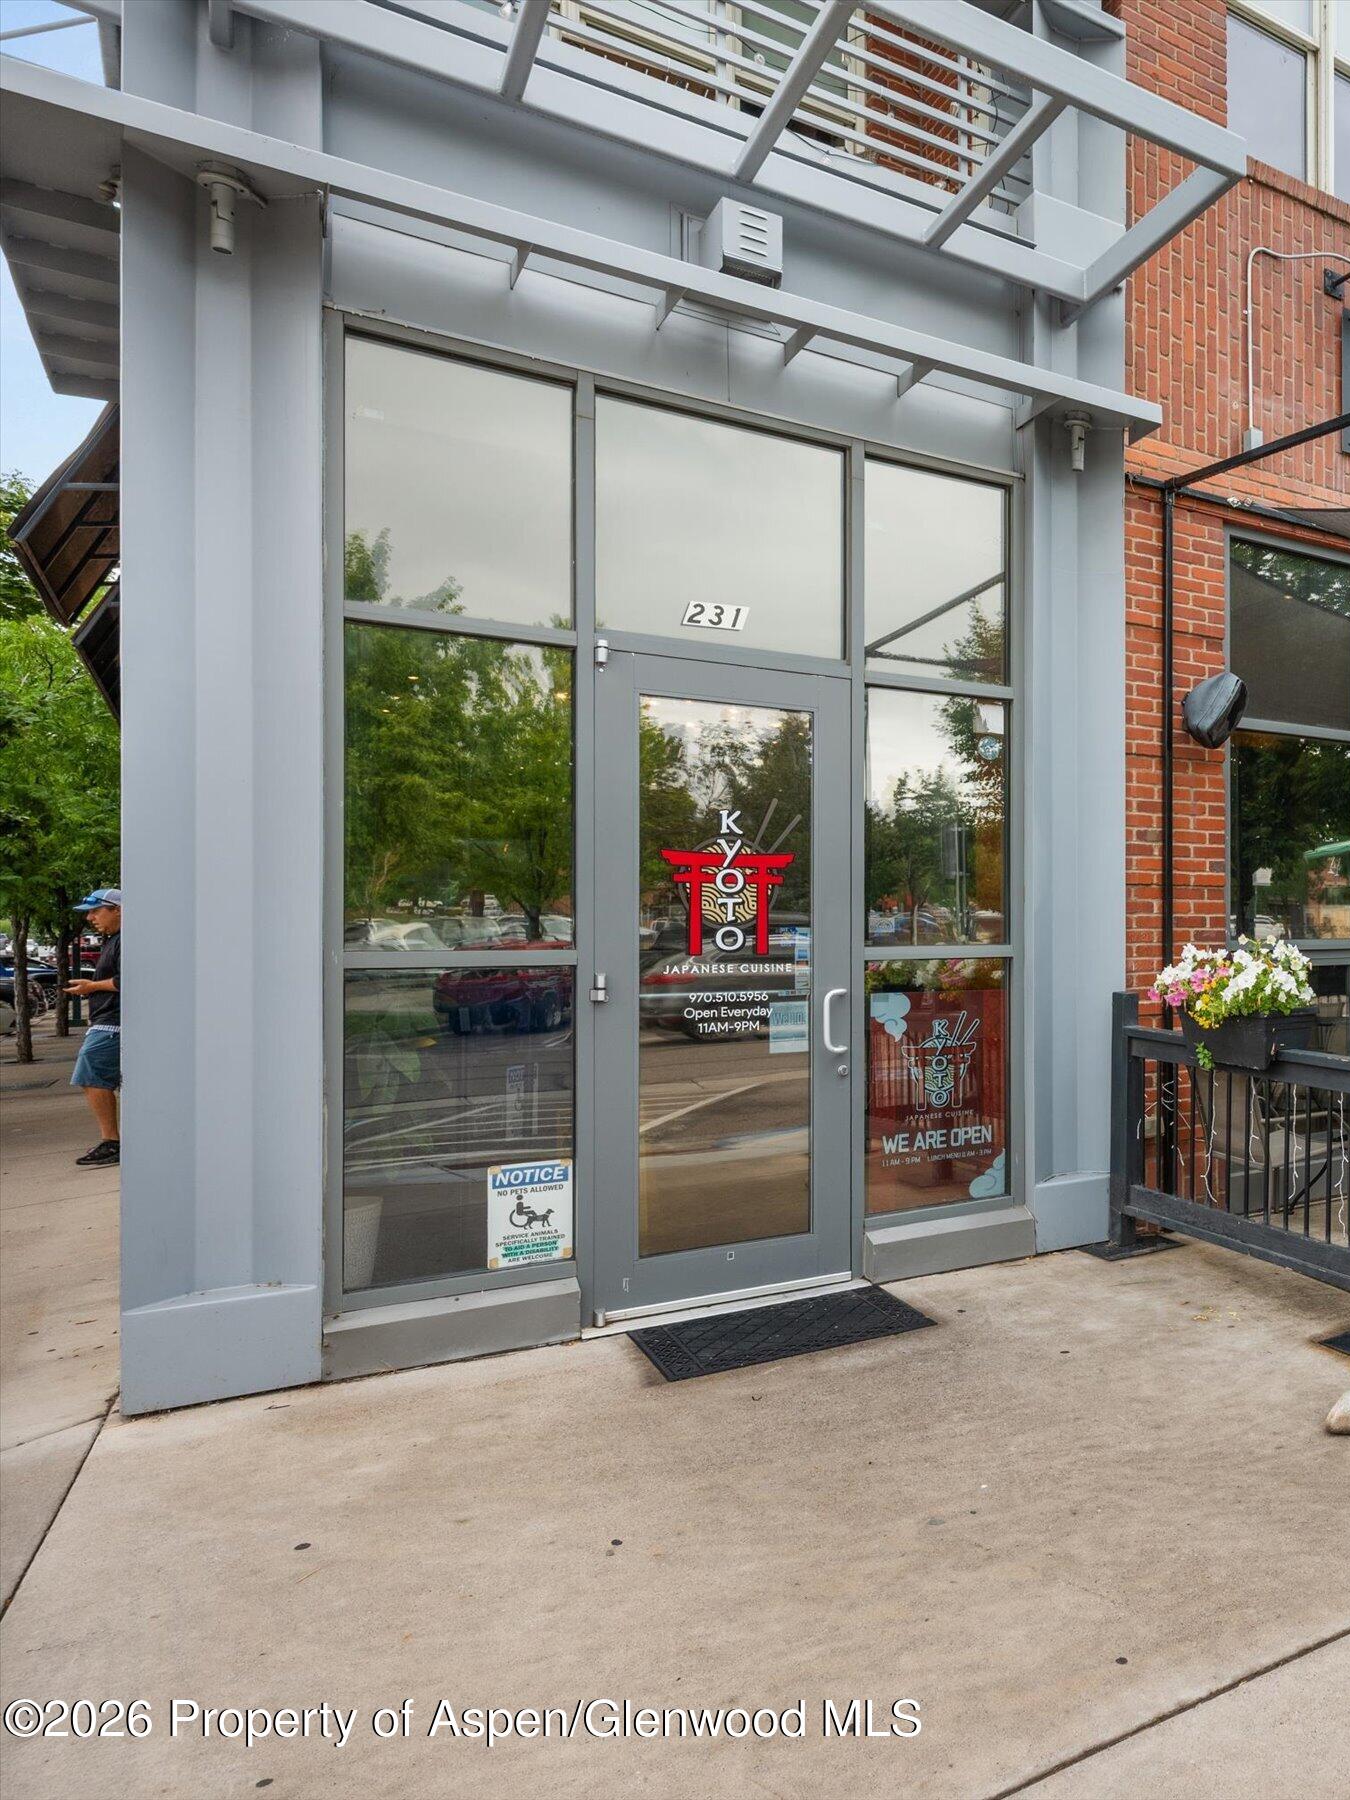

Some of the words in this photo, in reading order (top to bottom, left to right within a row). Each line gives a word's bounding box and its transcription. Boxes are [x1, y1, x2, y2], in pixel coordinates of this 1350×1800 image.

[686, 602, 742, 629] 231
[715, 809, 745, 951] KYOTO
[663, 964, 734, 975] JAPANESE
[740, 963, 792, 974] CUISINE
[689, 991, 769, 1003] 970.510.5956
[684, 1008, 718, 1021] Open
[720, 1006, 773, 1020] Everyday
[697, 1020, 760, 1034] 11AM-9PM
[905, 1112, 942, 1122] JAPANESE
[945, 1109, 974, 1118] CUISINE
[882, 1134, 909, 1154] WE
[913, 1130, 947, 1150] ARE
[950, 1125, 992, 1146] OPEN
[495, 1166, 565, 1186] NOTICE
[497, 1189, 508, 1197] NO
[510, 1187, 528, 1195] PETS
[530, 1184, 564, 1194] ALLOWED
[530, 1229, 558, 1237] ANIMALS
[495, 1236, 538, 1247] SPECIFICALLY
[539, 1233, 566, 1242] TRAINED
[531, 1240, 558, 1248] PERSON
[521, 1252, 553, 1261] WELCOME
[525, 1246, 559, 1256] DISABILITY
